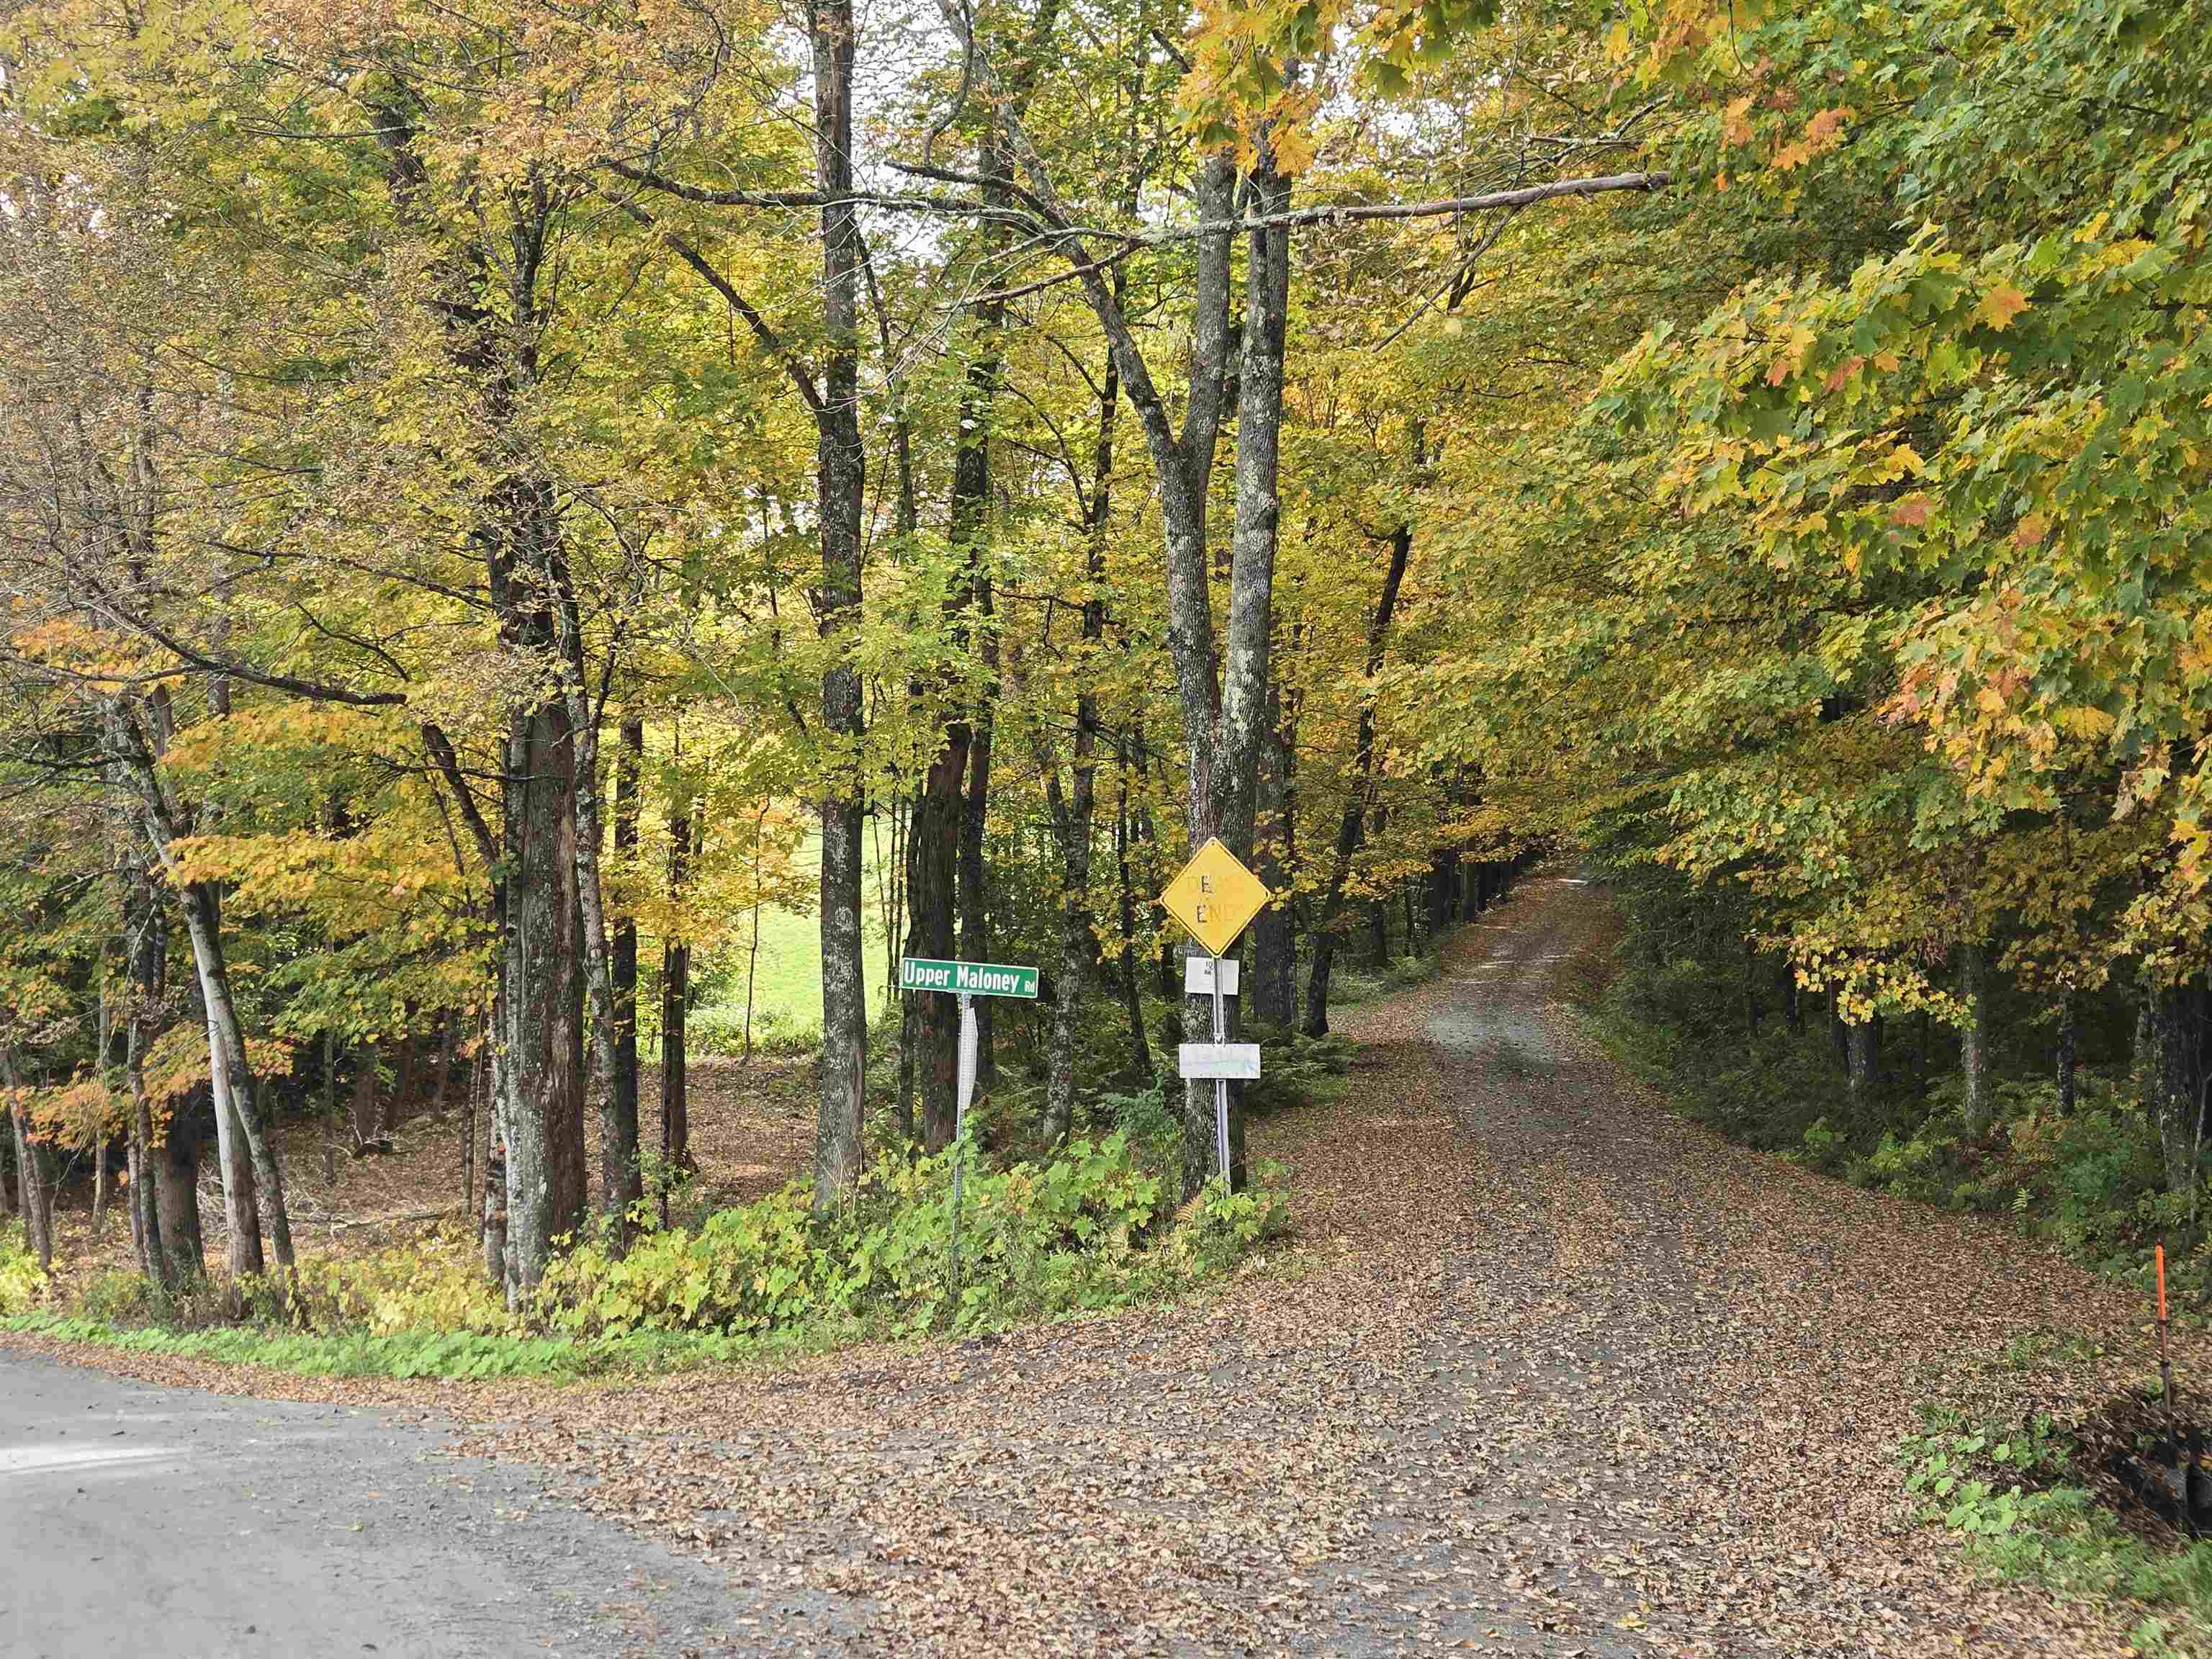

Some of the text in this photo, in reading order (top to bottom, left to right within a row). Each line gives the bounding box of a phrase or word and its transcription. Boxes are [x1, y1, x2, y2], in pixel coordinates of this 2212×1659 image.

[904, 961, 1035, 994] Upper Maloney Rd
